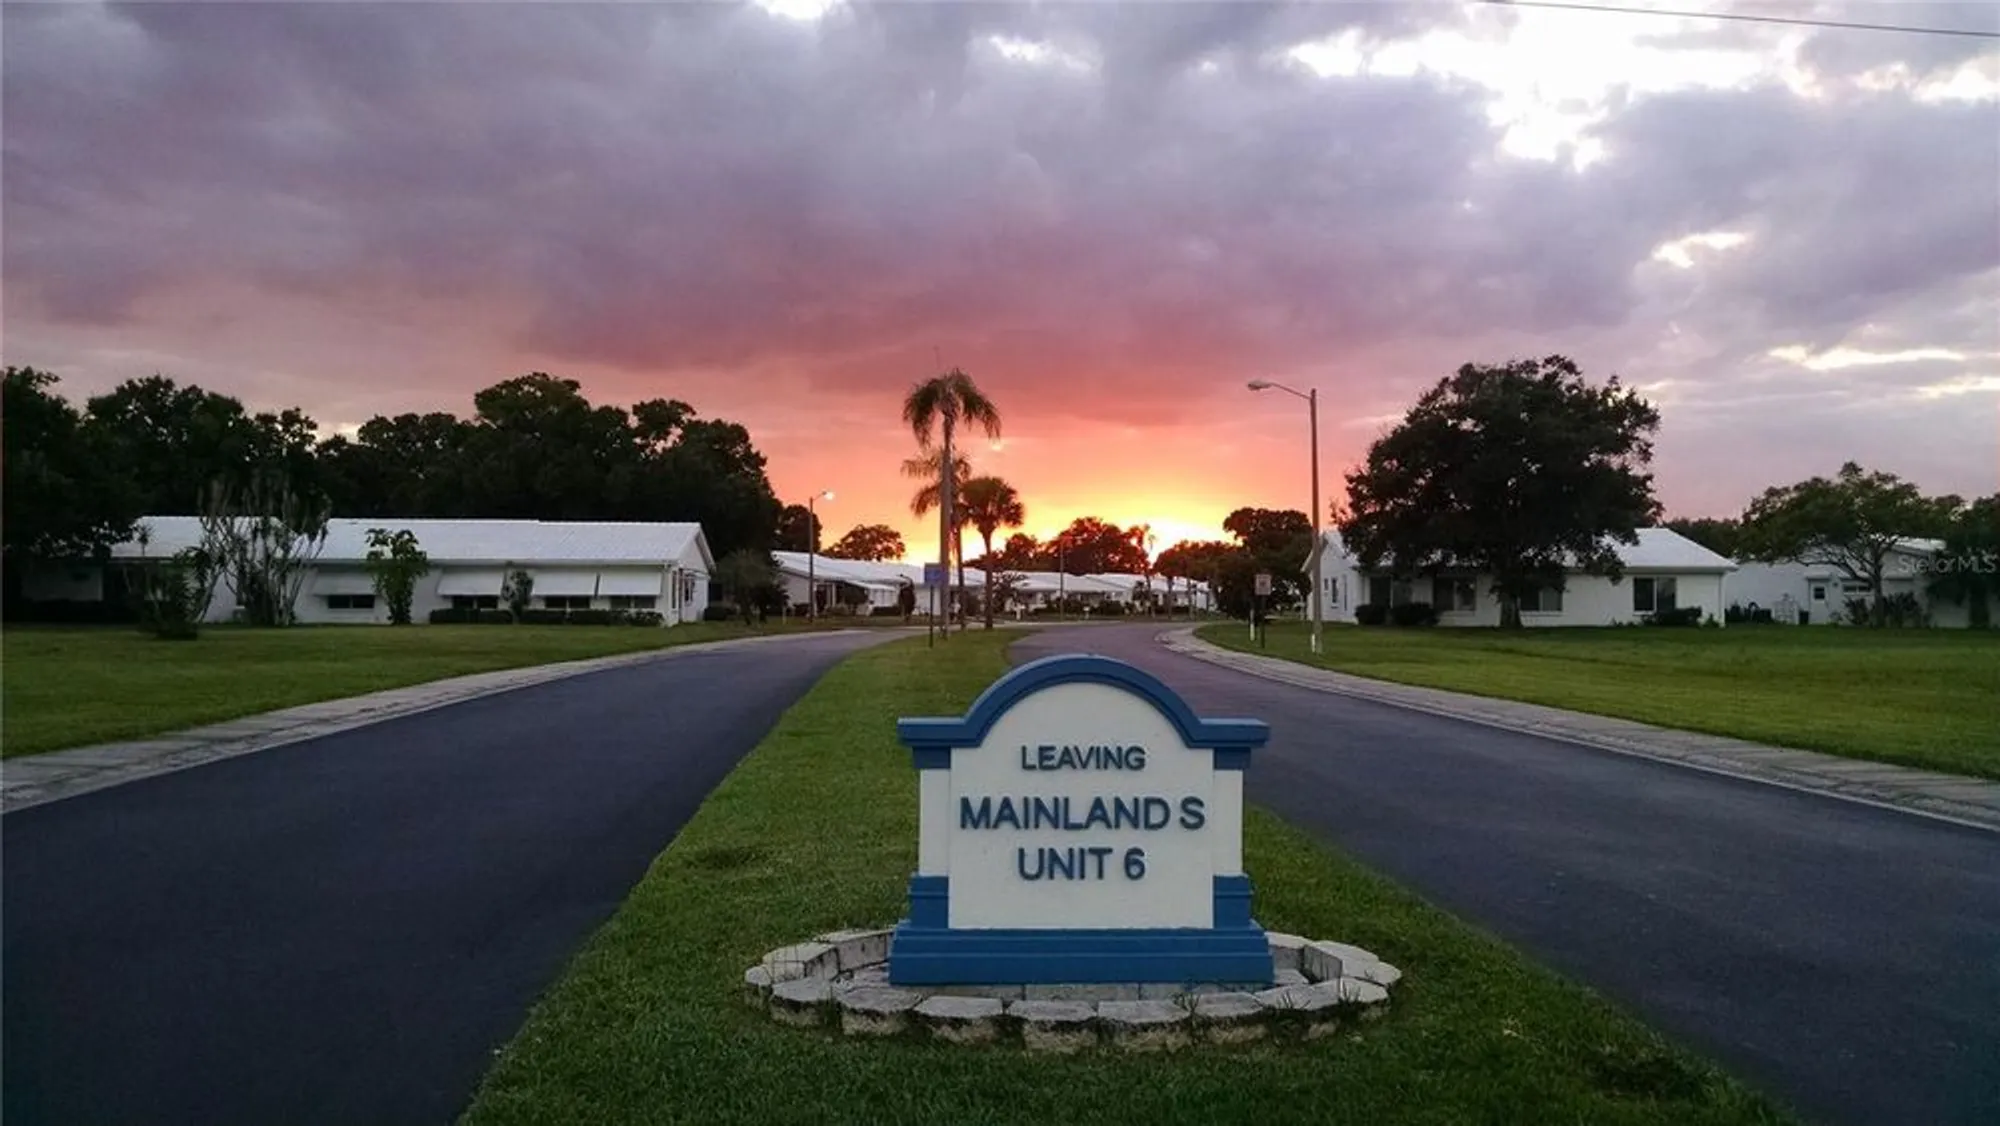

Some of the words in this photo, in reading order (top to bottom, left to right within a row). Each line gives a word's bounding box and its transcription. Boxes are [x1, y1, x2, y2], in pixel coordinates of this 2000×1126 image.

[1020, 745, 1146, 771] LEAVING
[1018, 847, 1113, 880] UNIT
[1123, 847, 1146, 880] 6
